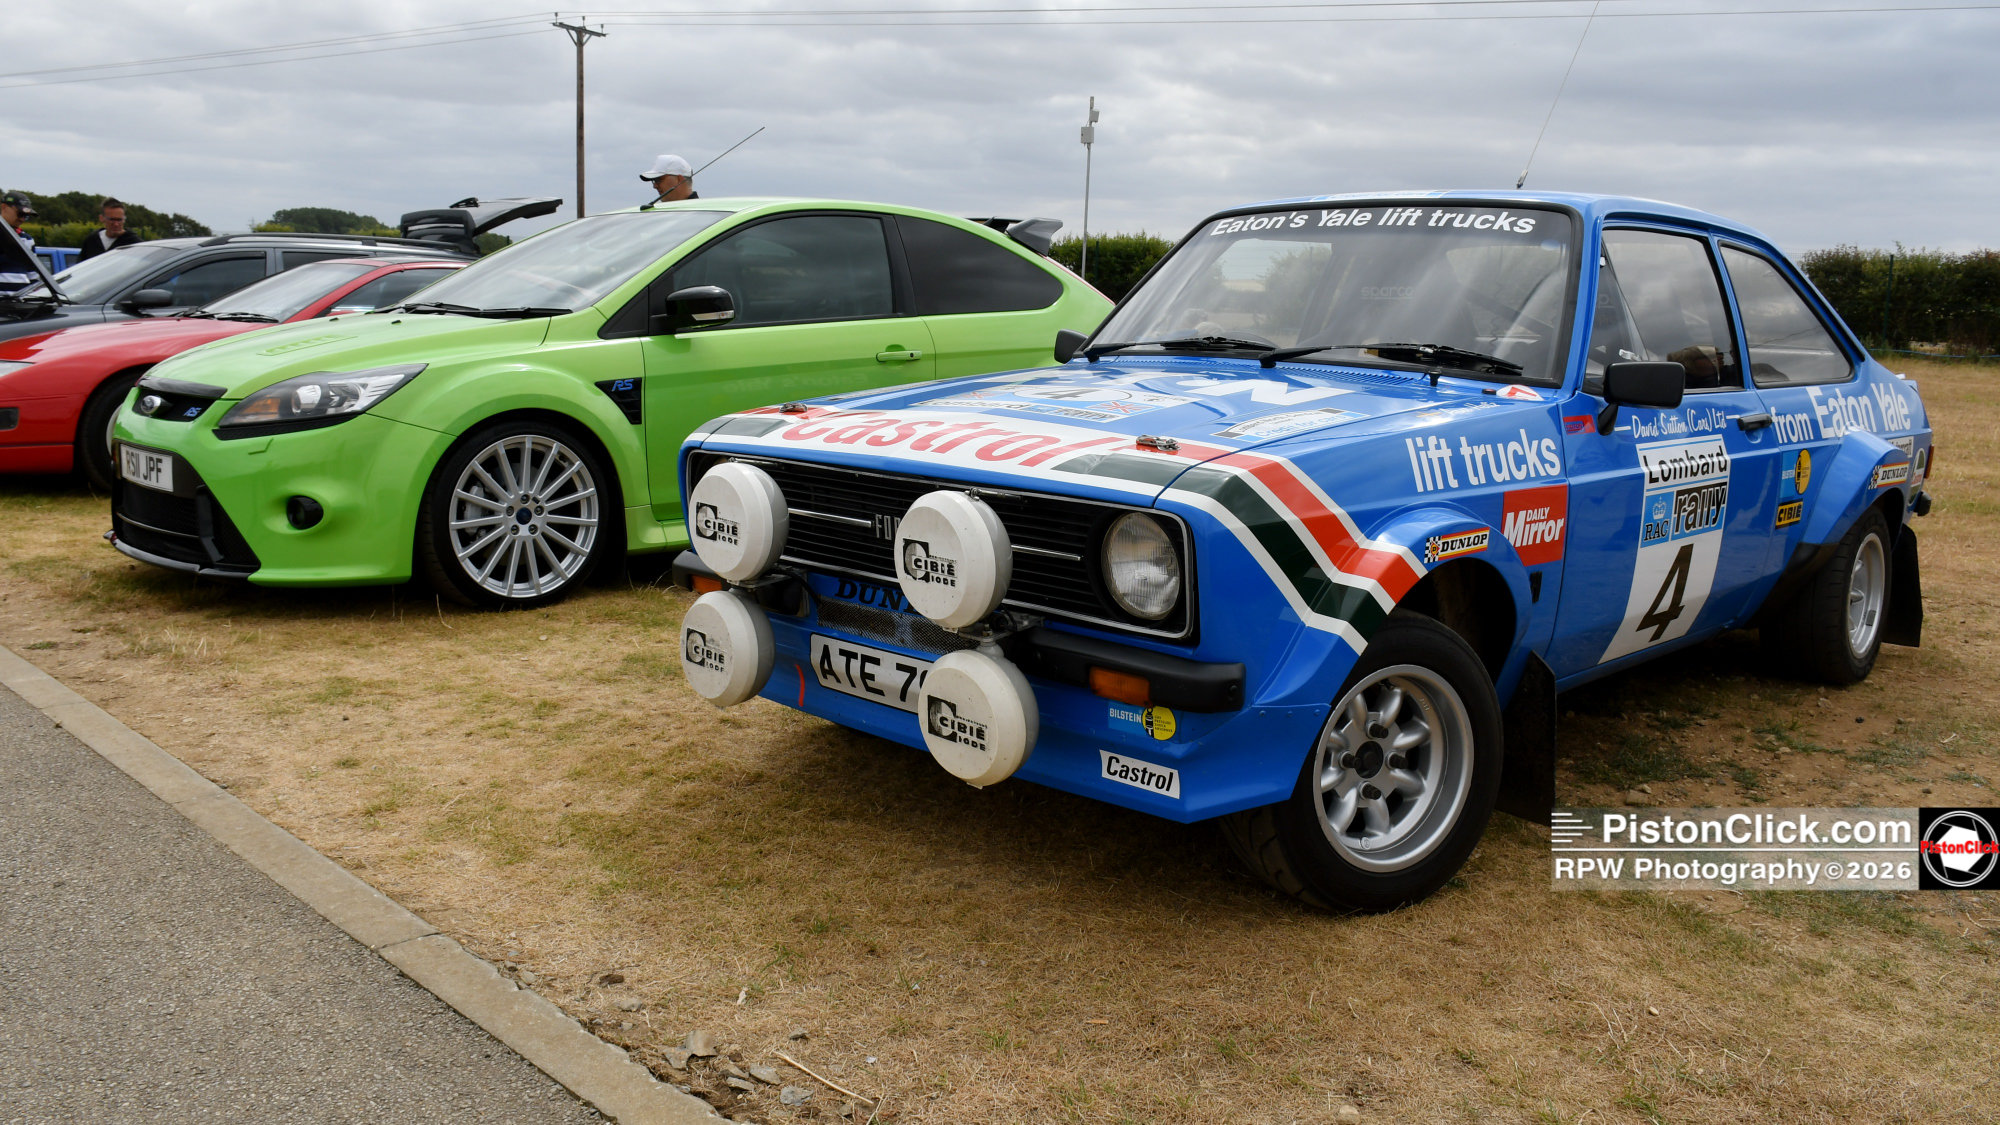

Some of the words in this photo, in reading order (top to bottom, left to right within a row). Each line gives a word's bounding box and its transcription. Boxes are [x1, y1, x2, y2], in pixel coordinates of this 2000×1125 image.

[1210, 211, 1308, 236] Eaton's
[1317, 209, 1372, 228] Yale
[1377, 208, 1420, 227] lift
[1427, 210, 1536, 234] trucks
[612, 379, 634, 392] RS
[183, 407, 201, 417] RS
[1632, 415, 1659, 438] David
[1660, 413, 1688, 435] Sutton
[1687, 408, 1712, 432] (Cars)
[1712, 408, 1727, 429] Ltd
[1770, 406, 1814, 443] from
[1806, 386, 1877, 439] Eaton
[1871, 383, 1911, 432] Yale
[782, 411, 1128, 467] Castrol
[143, 455, 163, 483] JPF
[1405, 436, 1459, 492] lift
[1460, 429, 1561, 486] trucks
[1643, 445, 1728, 484] Lombard
[1881, 467, 1908, 480] DUNLOP
[1526, 507, 1550, 522] DAILY
[1674, 486, 1727, 535] rally
[1441, 534, 1488, 552] DUNLOP
[1503, 510, 1565, 548] Mirror
[1644, 520, 1669, 541] RAC
[931, 575, 956, 587] IODE
[1636, 543, 1694, 642] 4
[820, 644, 885, 696] ATE
[896, 662, 928, 702] 7
[1109, 707, 1141, 723] BILSTEIN
[959, 735, 986, 751] IODE
[1106, 755, 1173, 791] Castrol
